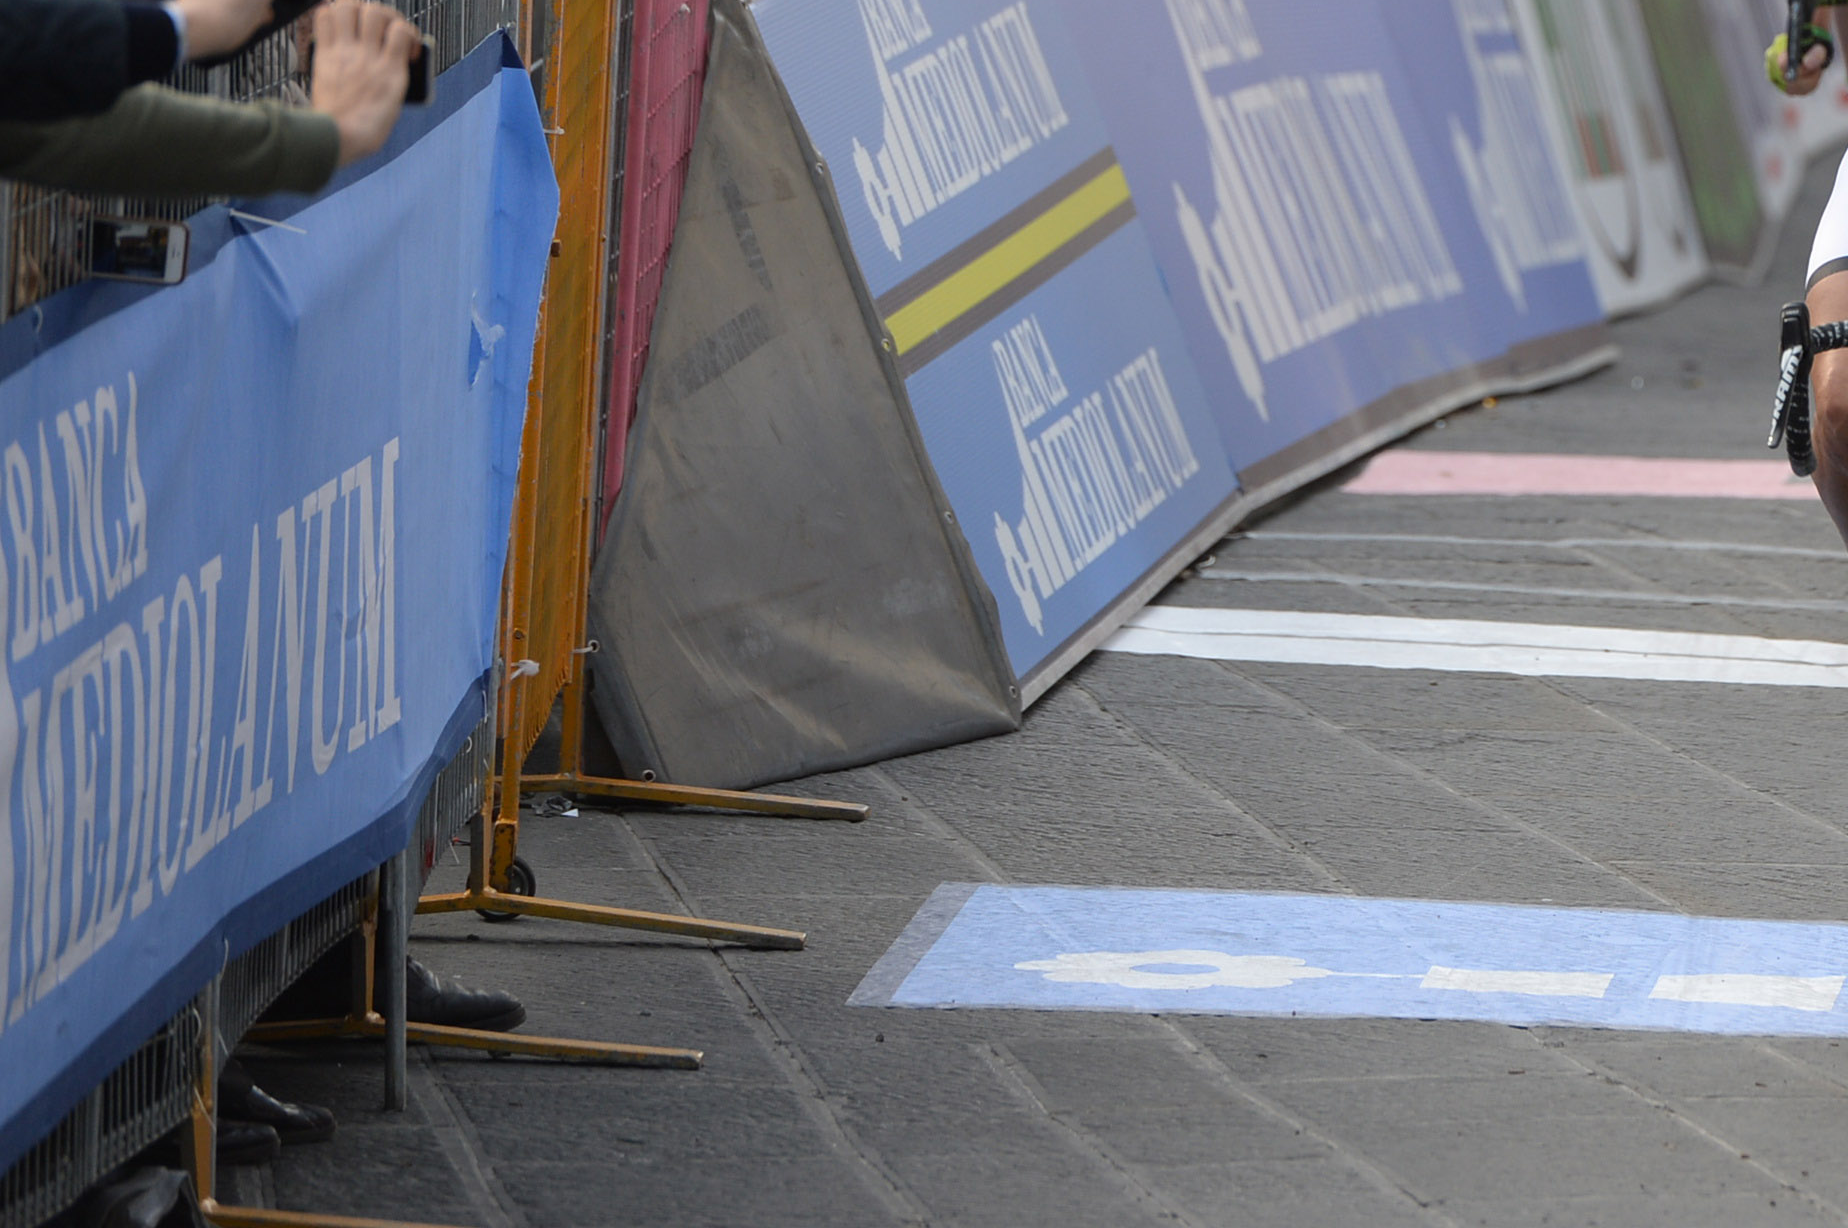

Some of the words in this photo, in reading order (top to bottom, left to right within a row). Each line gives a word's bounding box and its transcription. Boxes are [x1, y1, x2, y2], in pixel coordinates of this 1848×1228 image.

[890, 0, 1069, 206] MEDIOLANUM
[992, 313, 1069, 428] BANCA
[1029, 346, 1200, 573] MEDIOLANUM
[7, 370, 148, 665] BANCA
[7, 435, 402, 1026] MEDIOLANUM
